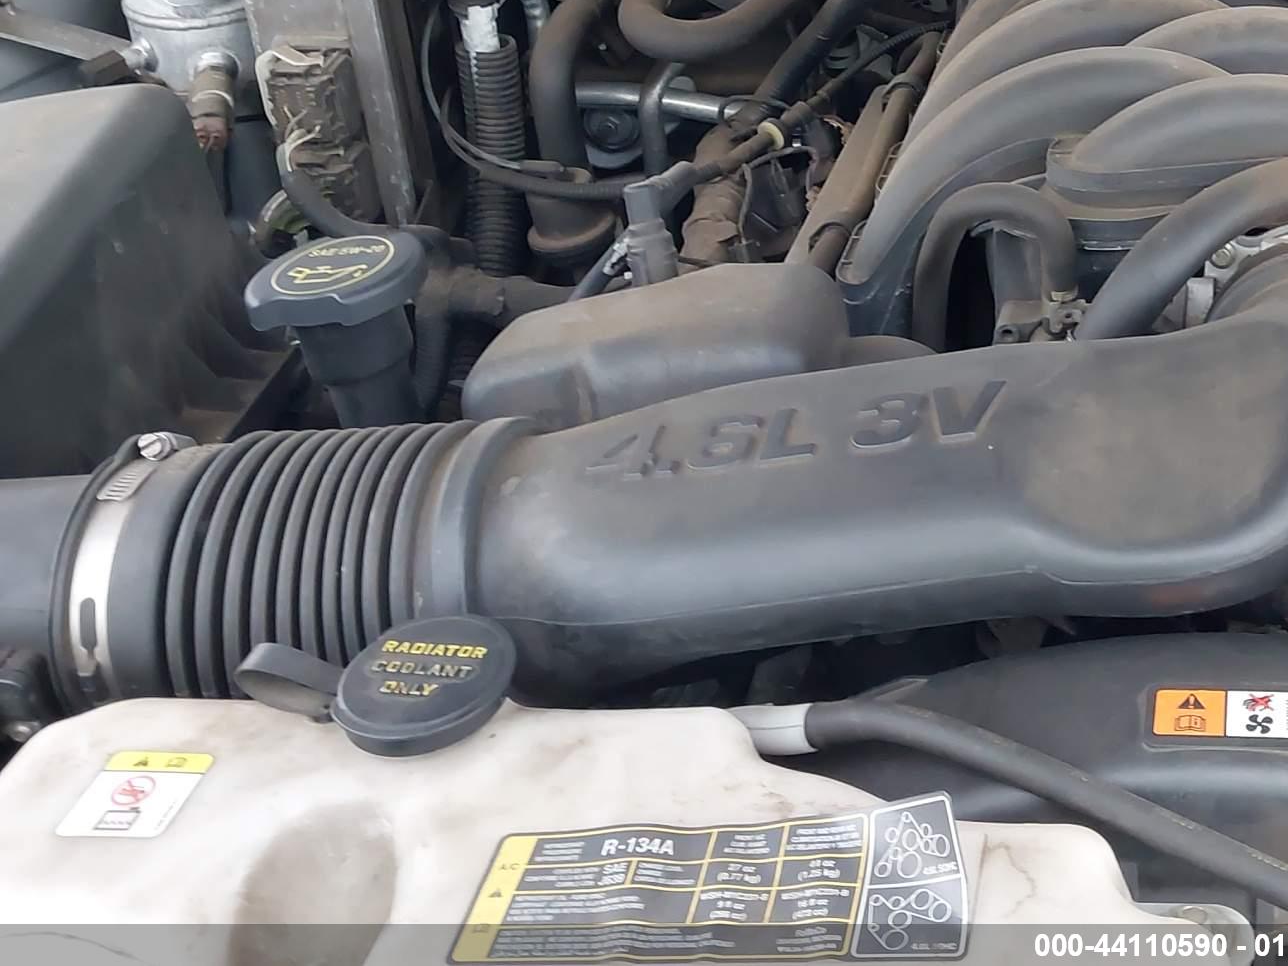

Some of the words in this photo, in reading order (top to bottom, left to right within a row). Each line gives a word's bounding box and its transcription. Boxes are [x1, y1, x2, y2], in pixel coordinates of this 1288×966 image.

[586, 407, 818, 480] 4.6L
[850, 379, 1007, 450] 3V
[381, 639, 488, 659] RADIATOR
[370, 660, 473, 678] COOLANT
[379, 680, 439, 697] ONLY
[600, 837, 675, 857] R-134A
